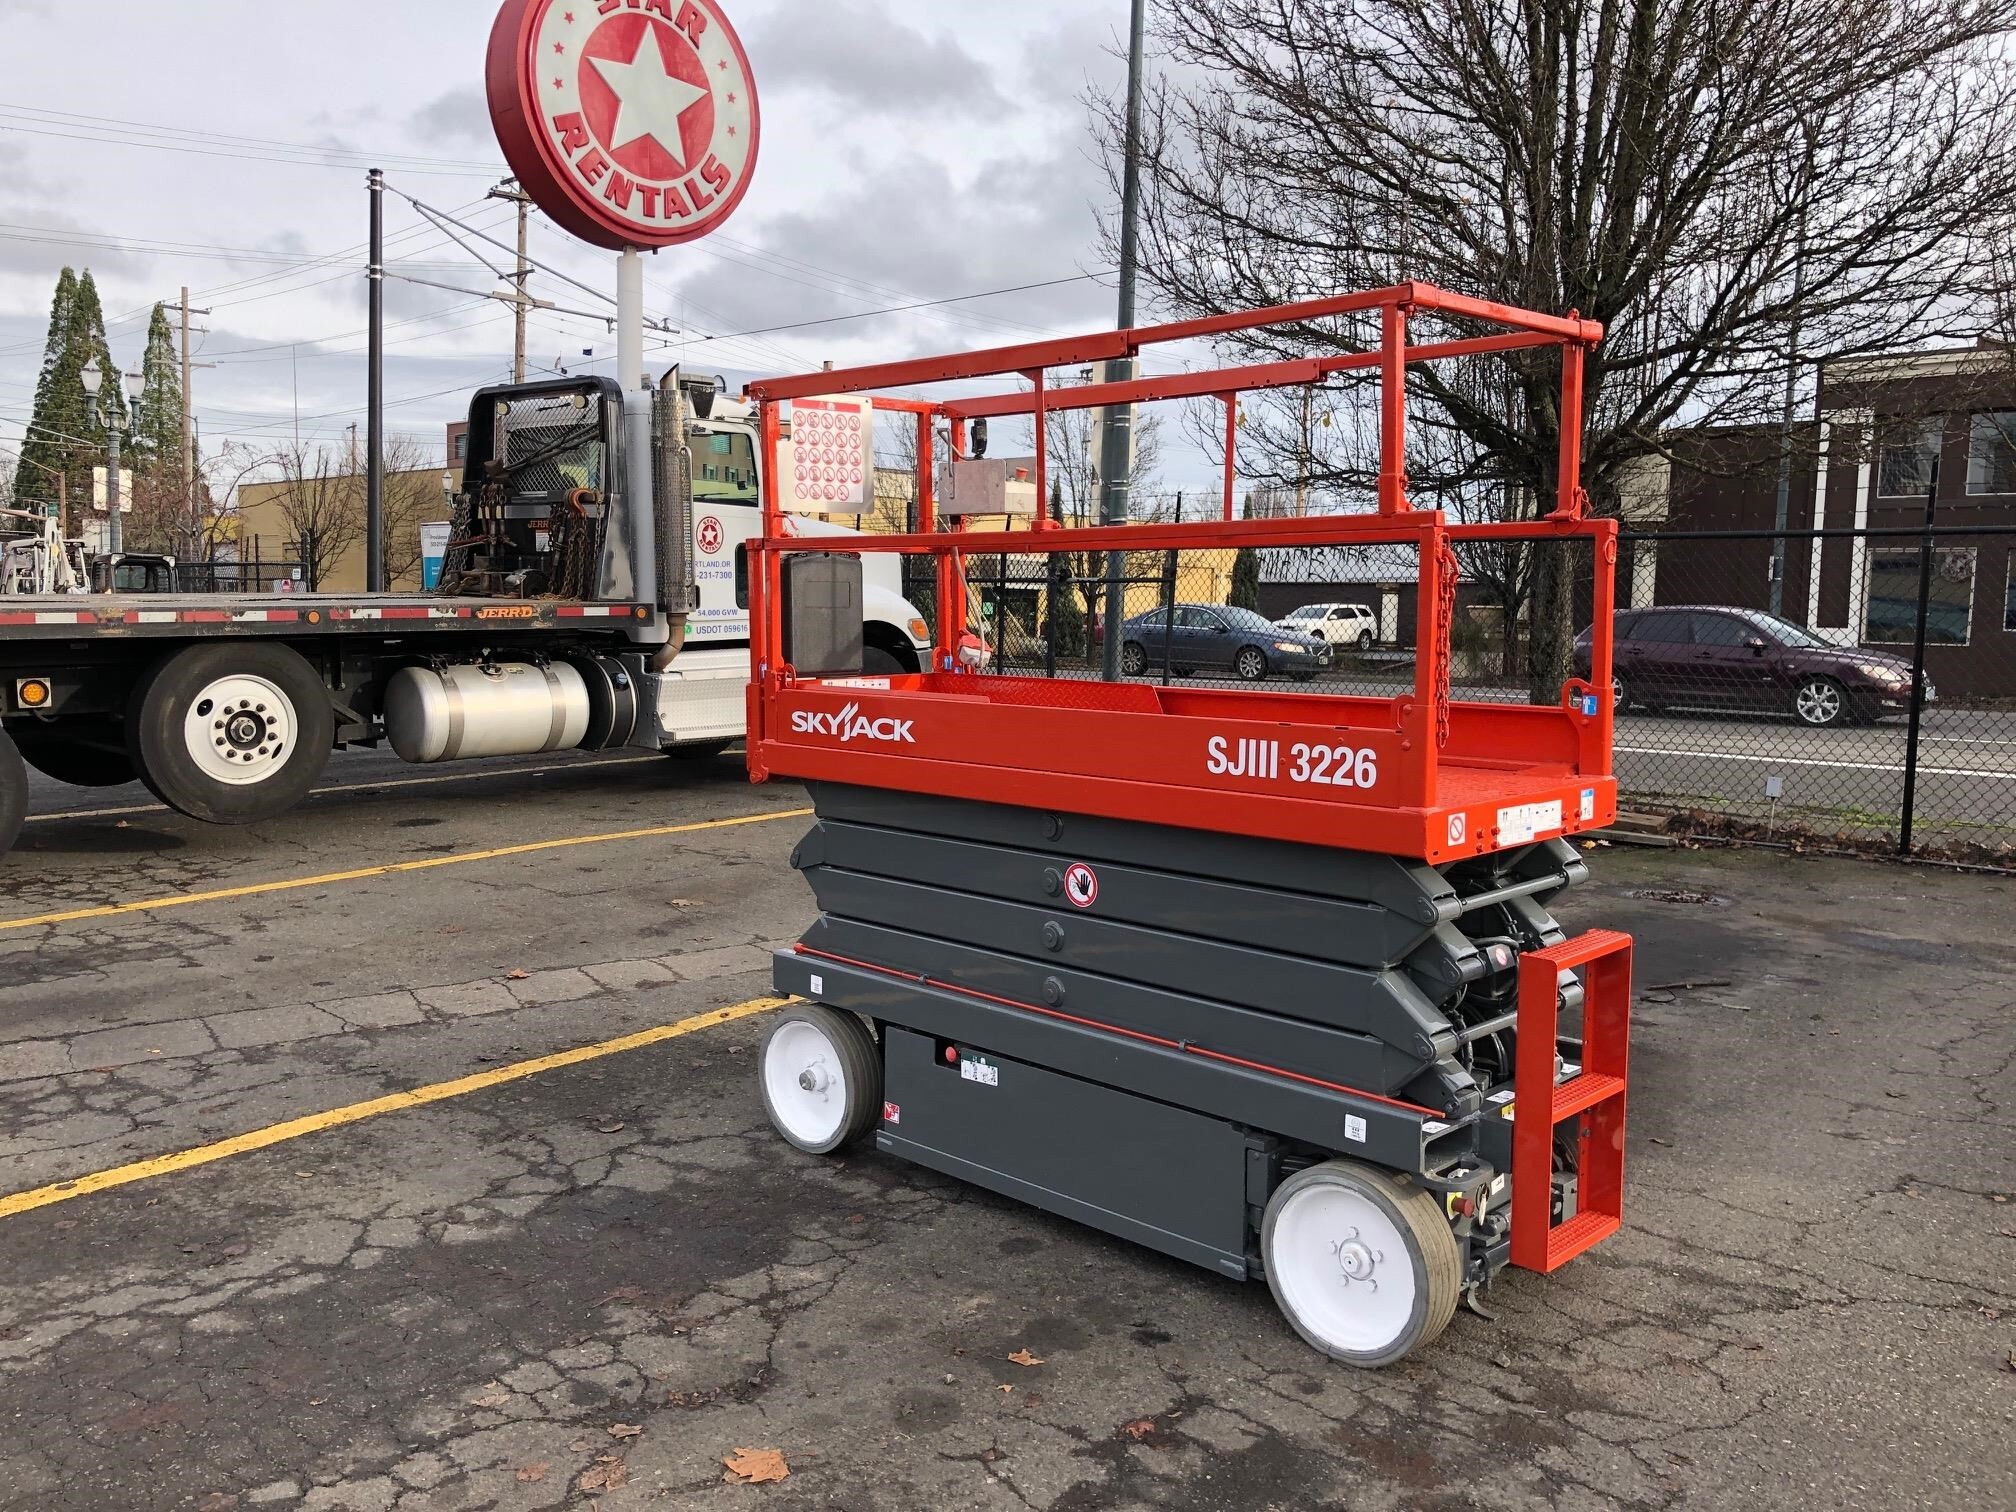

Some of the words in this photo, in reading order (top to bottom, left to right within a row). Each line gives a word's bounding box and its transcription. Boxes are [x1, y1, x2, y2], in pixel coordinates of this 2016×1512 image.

[553, 112, 731, 219] RENTALS
[696, 625, 722, 635] USDOT
[791, 701, 917, 743] SKYJACK
[1289, 742, 1378, 789] 3226
